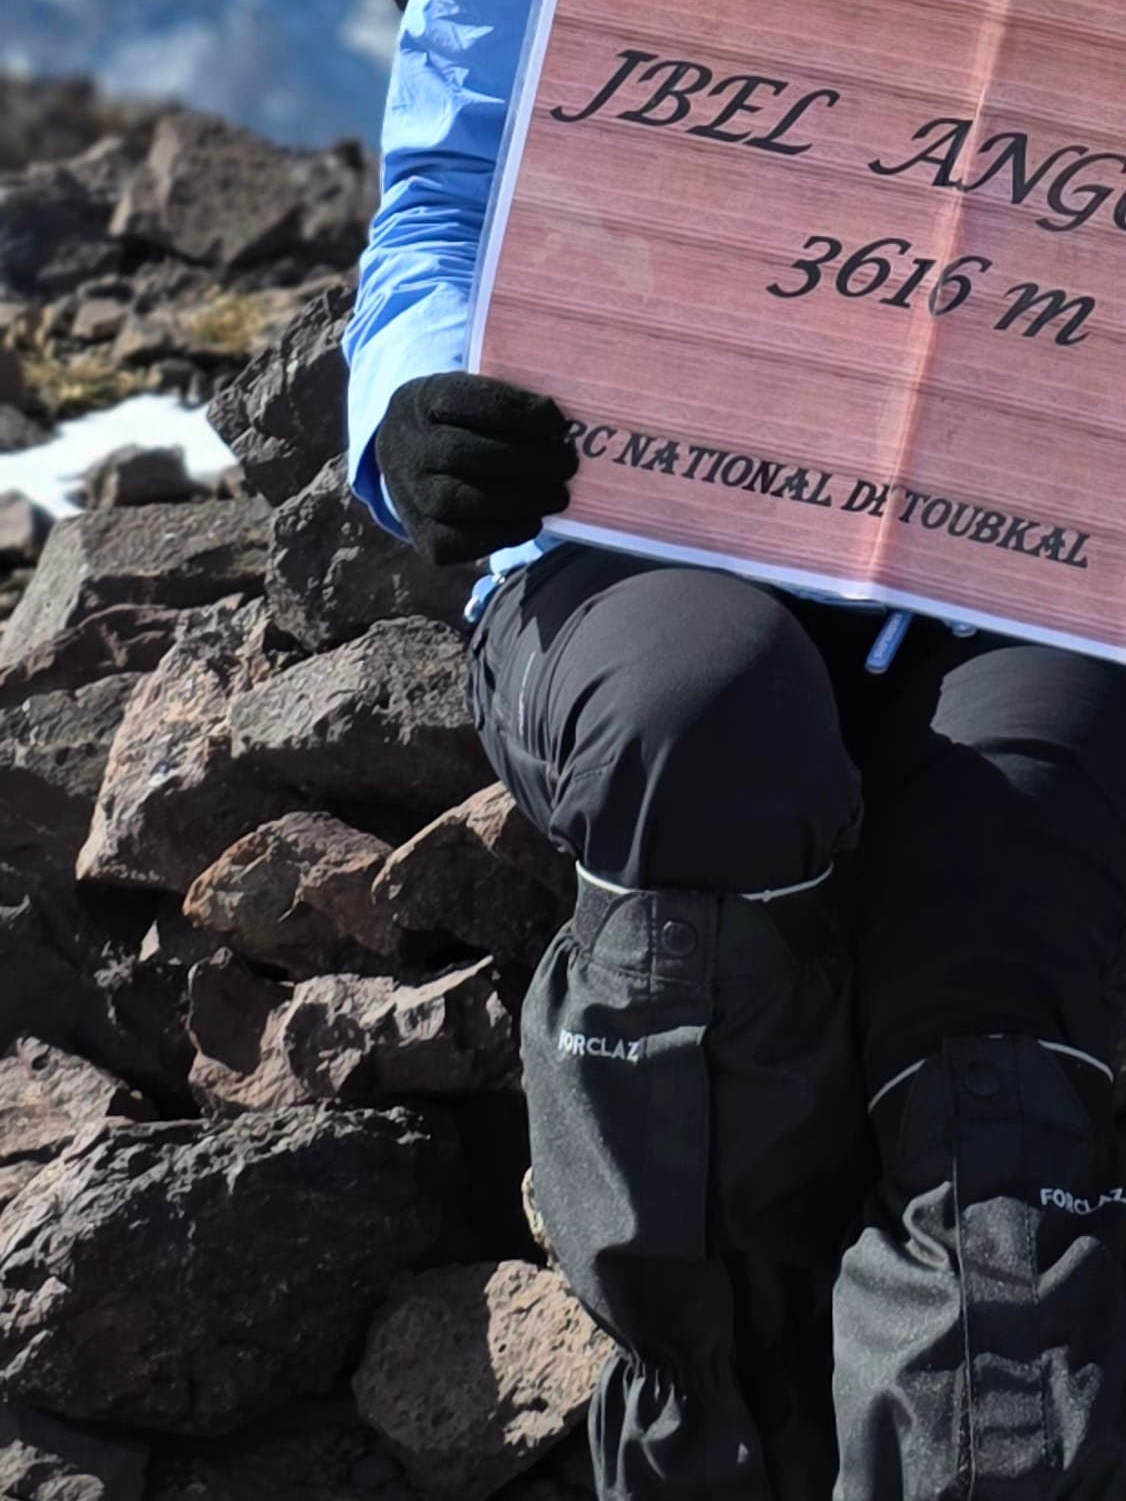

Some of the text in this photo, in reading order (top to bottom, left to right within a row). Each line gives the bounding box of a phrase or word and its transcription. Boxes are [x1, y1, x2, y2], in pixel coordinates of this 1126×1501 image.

[549, 49, 841, 156] JBEL
[765, 235, 1096, 346] 3616 m
[562, 419, 618, 458] RC
[612, 432, 834, 508] NATIONAL
[898, 488, 1092, 568] TOUBKAL
